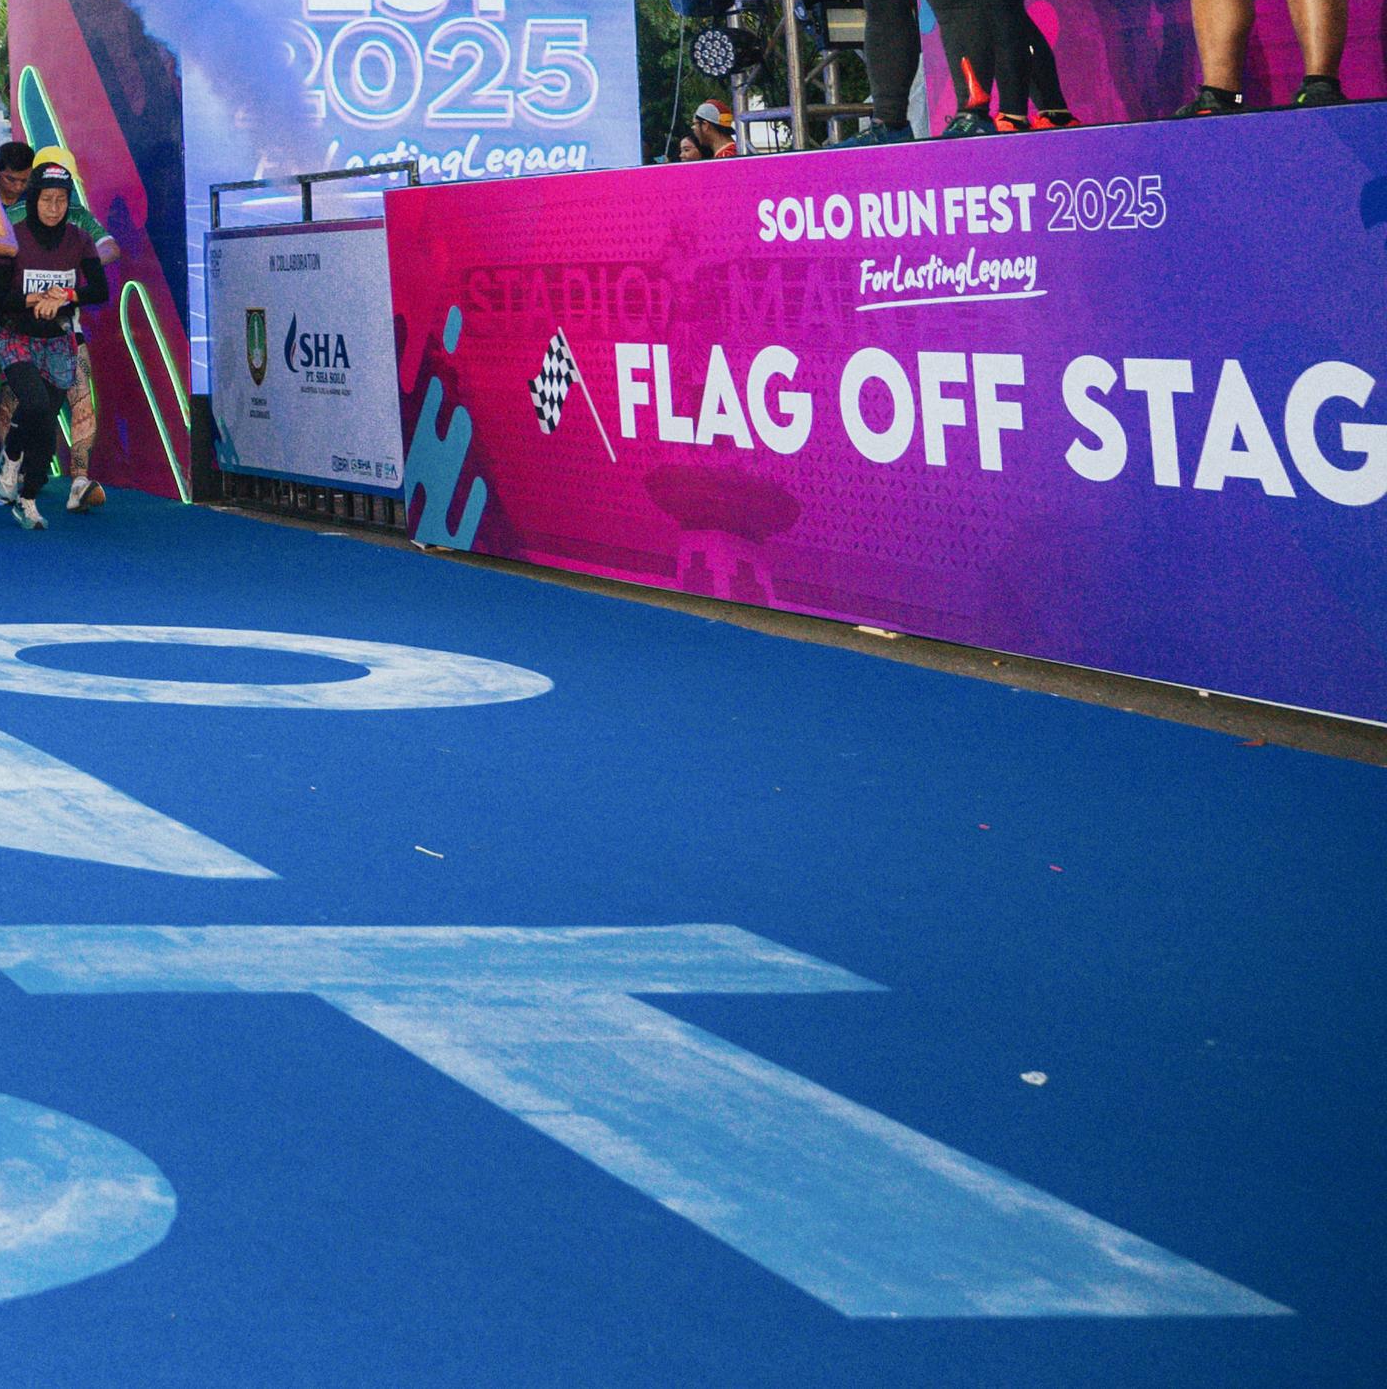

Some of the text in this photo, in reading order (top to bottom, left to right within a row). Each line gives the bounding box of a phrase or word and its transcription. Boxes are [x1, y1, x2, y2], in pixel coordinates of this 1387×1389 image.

[757, 175, 1167, 243] SOLO RUN FEST 2025
[860, 248, 1039, 295] ForLastingLegacy
[299, 332, 351, 369] SHA
[615, 341, 813, 455] FLAG
[839, 346, 1026, 472] OFF
